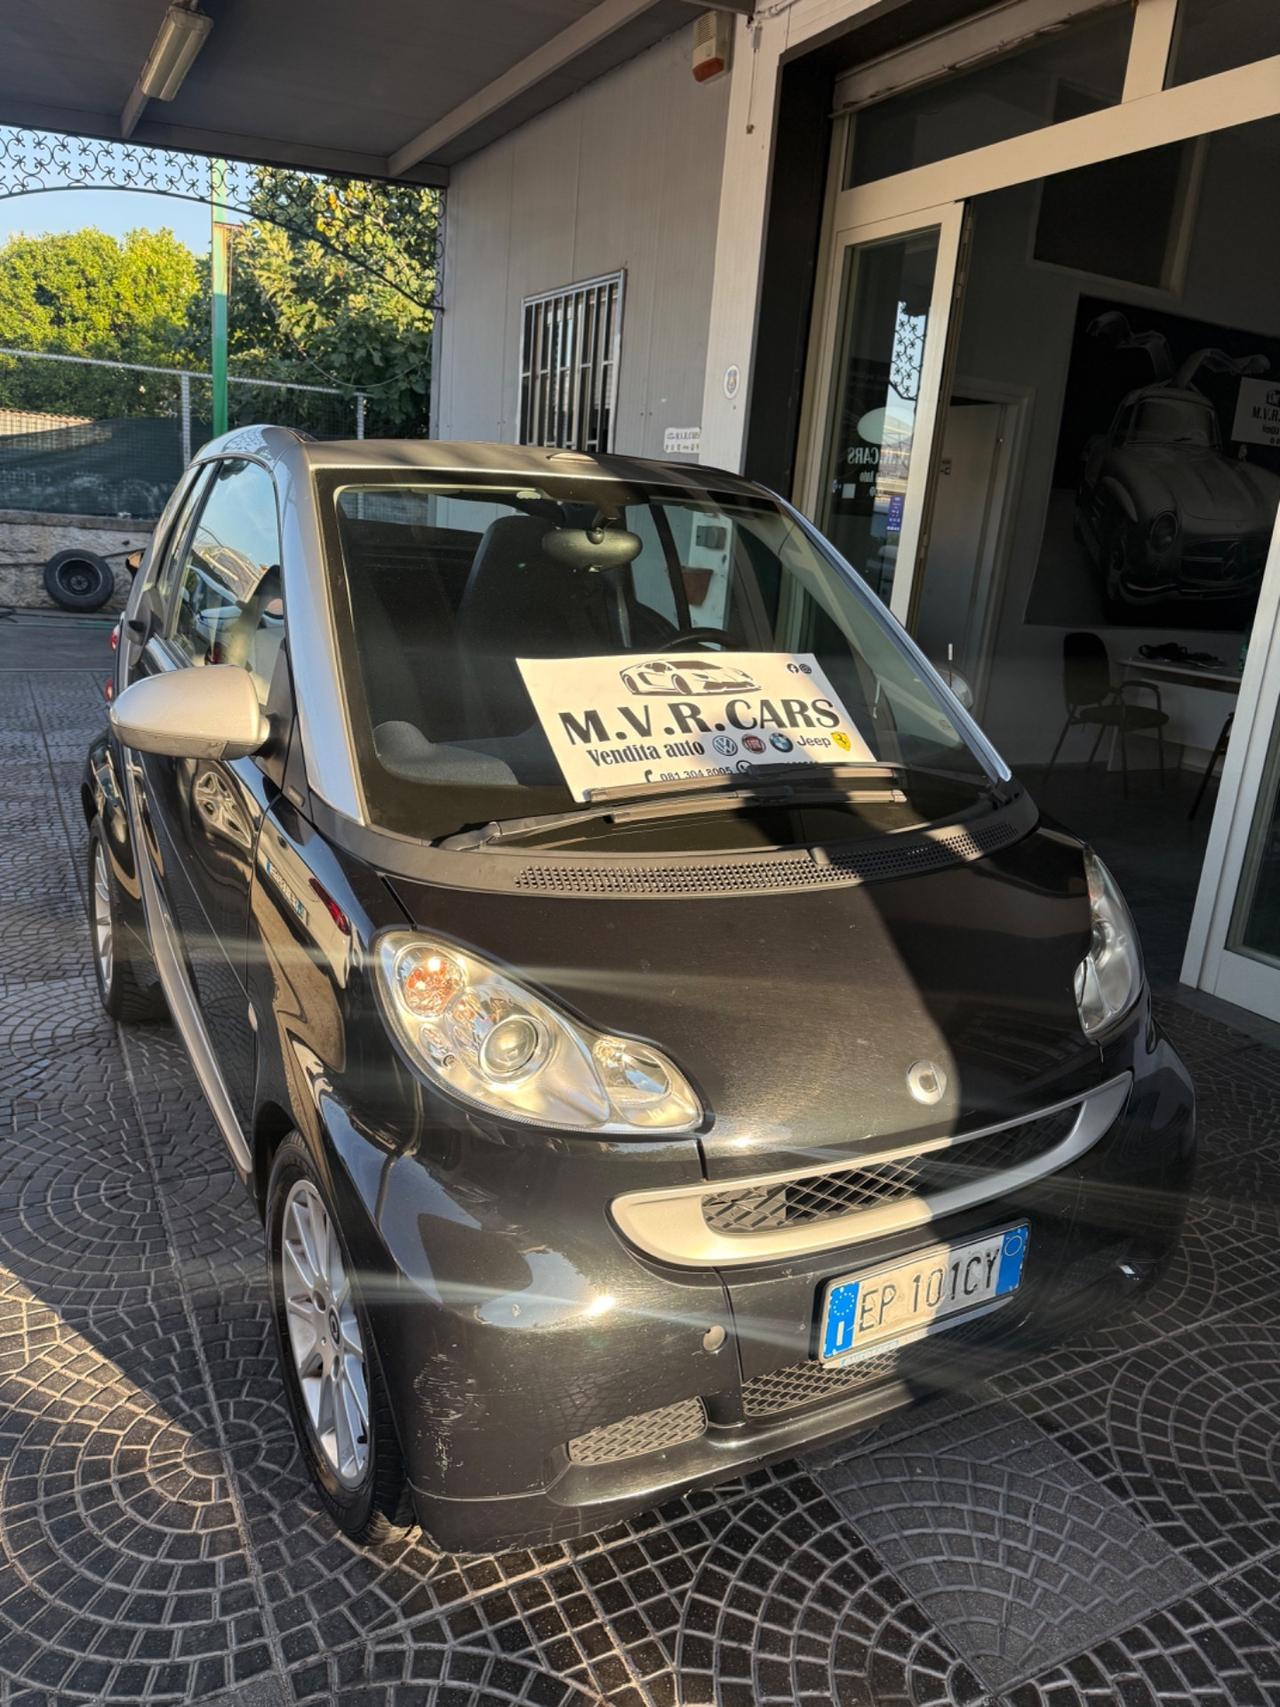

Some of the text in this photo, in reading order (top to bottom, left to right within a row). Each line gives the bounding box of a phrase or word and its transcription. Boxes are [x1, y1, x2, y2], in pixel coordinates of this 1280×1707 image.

[558, 699, 841, 746] M.V.R.CARS
[586, 744, 661, 767] Vendita
[664, 740, 705, 758] auto
[797, 734, 831, 748] Jeep
[859, 1248, 1000, 1333] EP 101CY
